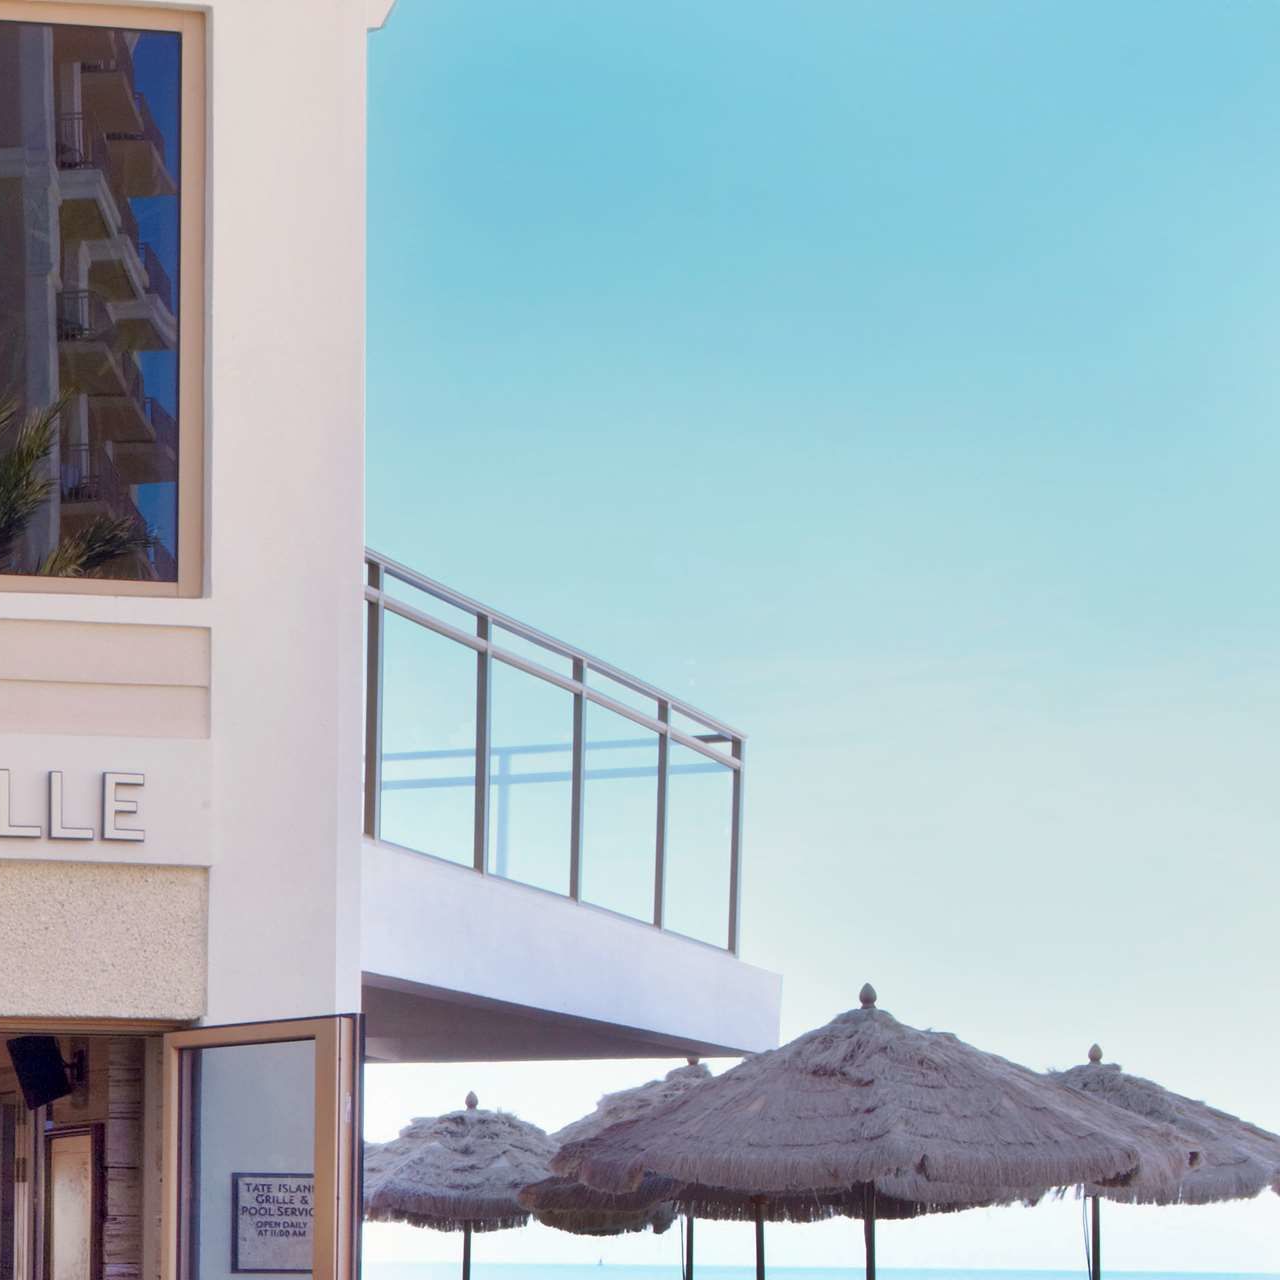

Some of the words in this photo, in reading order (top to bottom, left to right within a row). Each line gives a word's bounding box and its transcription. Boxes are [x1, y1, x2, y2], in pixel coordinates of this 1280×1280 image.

[245, 1183, 273, 1193] TATE
[278, 1183, 314, 1194] ISLAN
[255, 1194, 295, 1205] GRILLE
[299, 1195, 309, 1205] &
[241, 1206, 275, 1217] POOL
[255, 1221, 281, 1229] OPEN
[283, 1221, 308, 1229] DAILY
